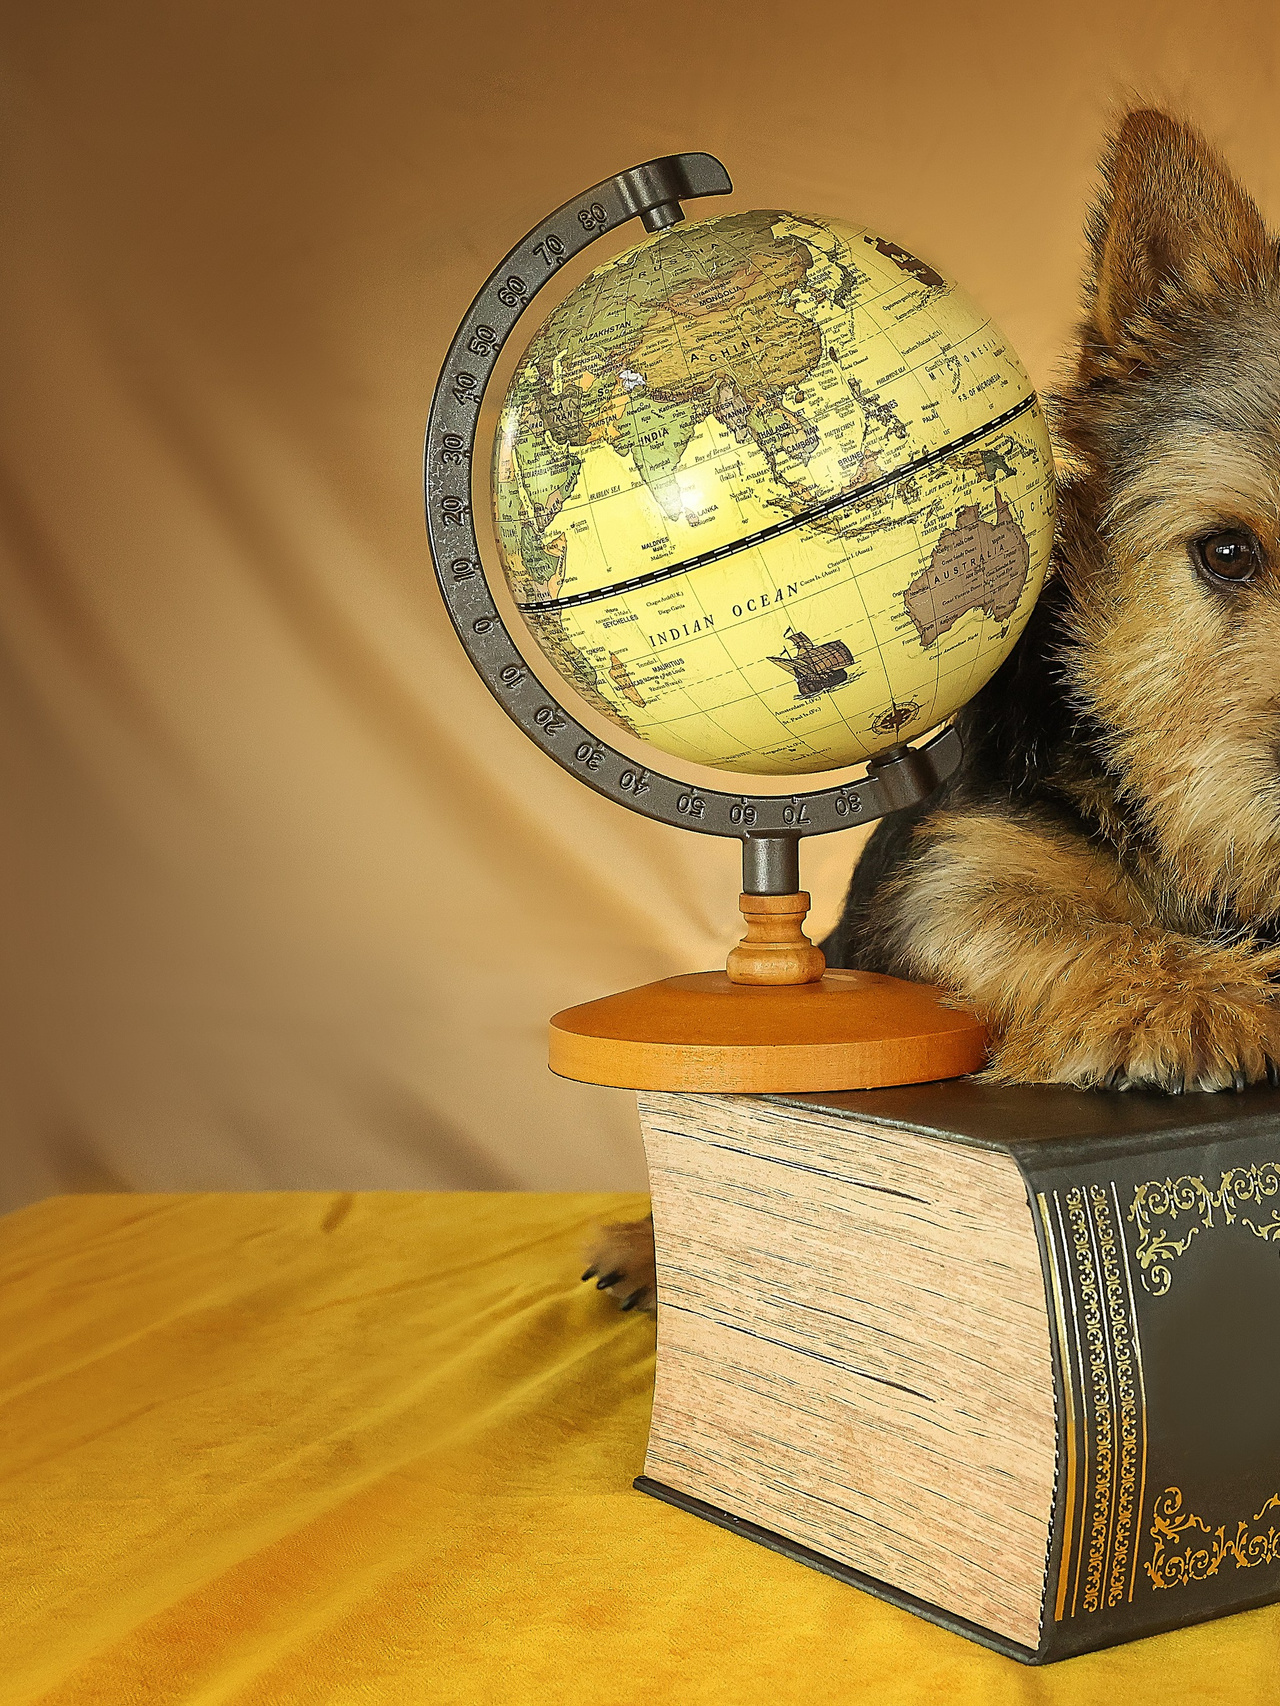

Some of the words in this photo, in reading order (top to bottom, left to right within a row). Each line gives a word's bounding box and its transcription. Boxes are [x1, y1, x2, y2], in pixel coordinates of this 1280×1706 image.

[577, 202, 608, 230] 80
[532, 233, 566, 266] 70
[497, 276, 528, 307] 60
[699, 286, 742, 306] MONGOLIA
[467, 323, 497, 357] 50
[578, 320, 631, 344] KAZAKHSTAN
[708, 335, 764, 362] CHINA
[451, 370, 478, 407] 40
[640, 427, 670, 445] INDIA
[804, 426, 819, 435] NAM
[442, 435, 465, 467] 30
[442, 497, 465, 527] 20
[697, 504, 719, 517] LANKA
[938, 512, 953, 523] TIMOR
[451, 558, 477, 583] 10
[933, 544, 1005, 585] AUSTRALIA
[473, 617, 494, 635] 0
[603, 614, 639, 628] SEYCHELLES
[648, 614, 715, 647] INDIAN
[732, 582, 799, 617] OCEAN
[499, 664, 526, 690] 10
[652, 658, 685, 673] MAURITIUS
[534, 706, 567, 737] 20
[574, 741, 606, 771] 30
[619, 769, 651, 797] 40
[676, 793, 707, 820] 50
[730, 803, 757, 826] 60
[782, 803, 812, 826] 70
[834, 793, 862, 817] 80
